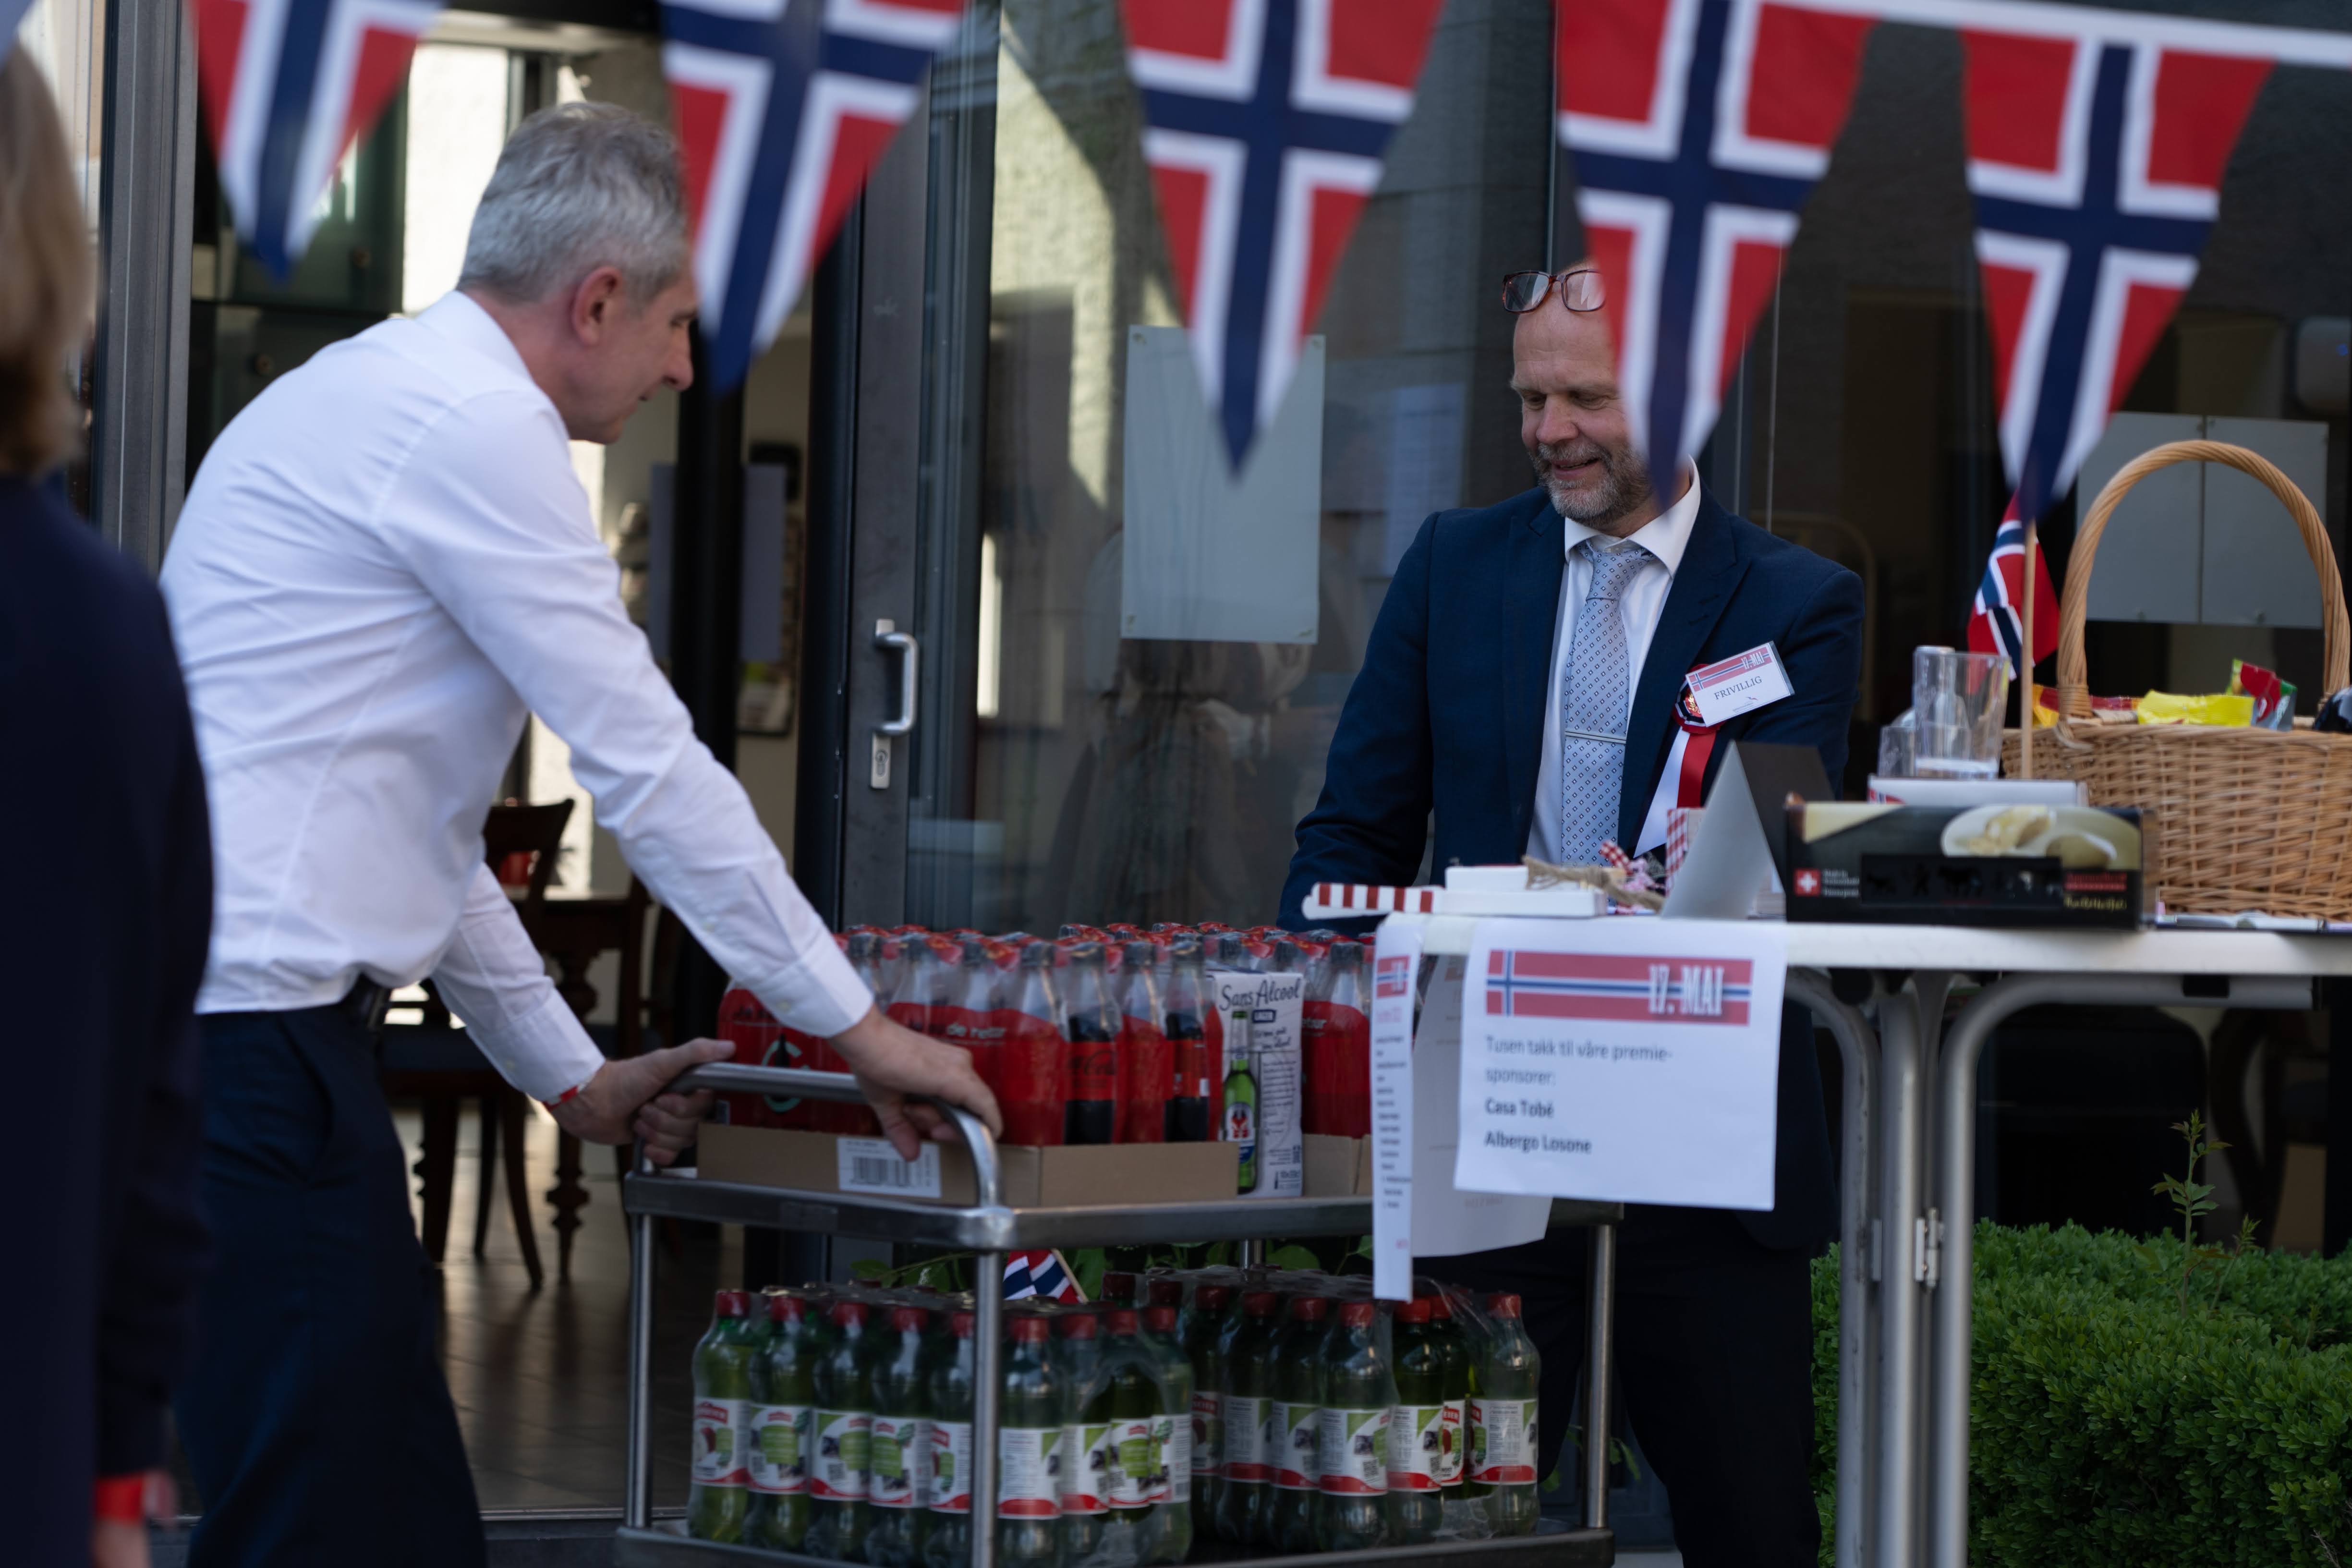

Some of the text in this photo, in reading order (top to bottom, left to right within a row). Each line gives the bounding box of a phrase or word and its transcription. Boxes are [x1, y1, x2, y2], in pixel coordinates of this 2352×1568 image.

[1750, 651, 1764, 666] MAI
[1714, 676, 1762, 700] FRIVILLIG
[1219, 978, 1301, 1011] Sans Alcool
[1649, 964, 1724, 1017] 17. MAI
[1486, 1034, 1526, 1054] Tusen
[1528, 1039, 1556, 1056] takk
[1558, 1039, 1574, 1057] til
[1576, 1041, 1609, 1058] våre
[1485, 1097, 1554, 1118] Casa Tobé
[1484, 1130, 1592, 1154] Albergo Losone
